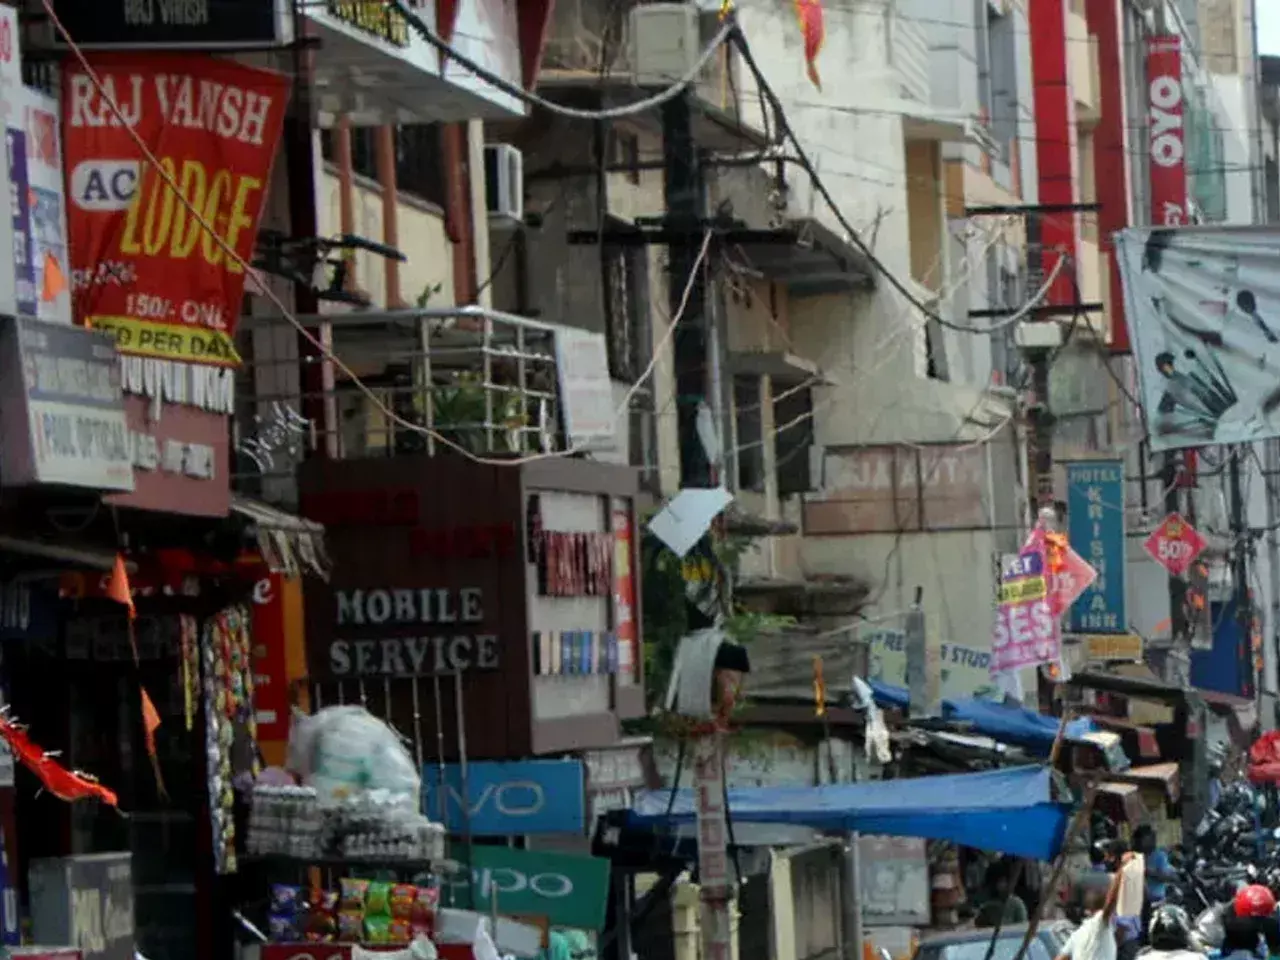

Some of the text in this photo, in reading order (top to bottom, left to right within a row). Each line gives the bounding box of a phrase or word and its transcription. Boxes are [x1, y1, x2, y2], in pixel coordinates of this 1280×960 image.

[70, 74, 272, 145] RAJ VANSH
[1150, 75, 1183, 167] OYO
[83, 169, 136, 201] AC
[120, 157, 260, 274] LODGE
[139, 329, 184, 352] PER
[1071, 469, 1117, 482] HOTEL
[336, 587, 484, 624] MOBILE
[330, 634, 500, 673] SERVICE
